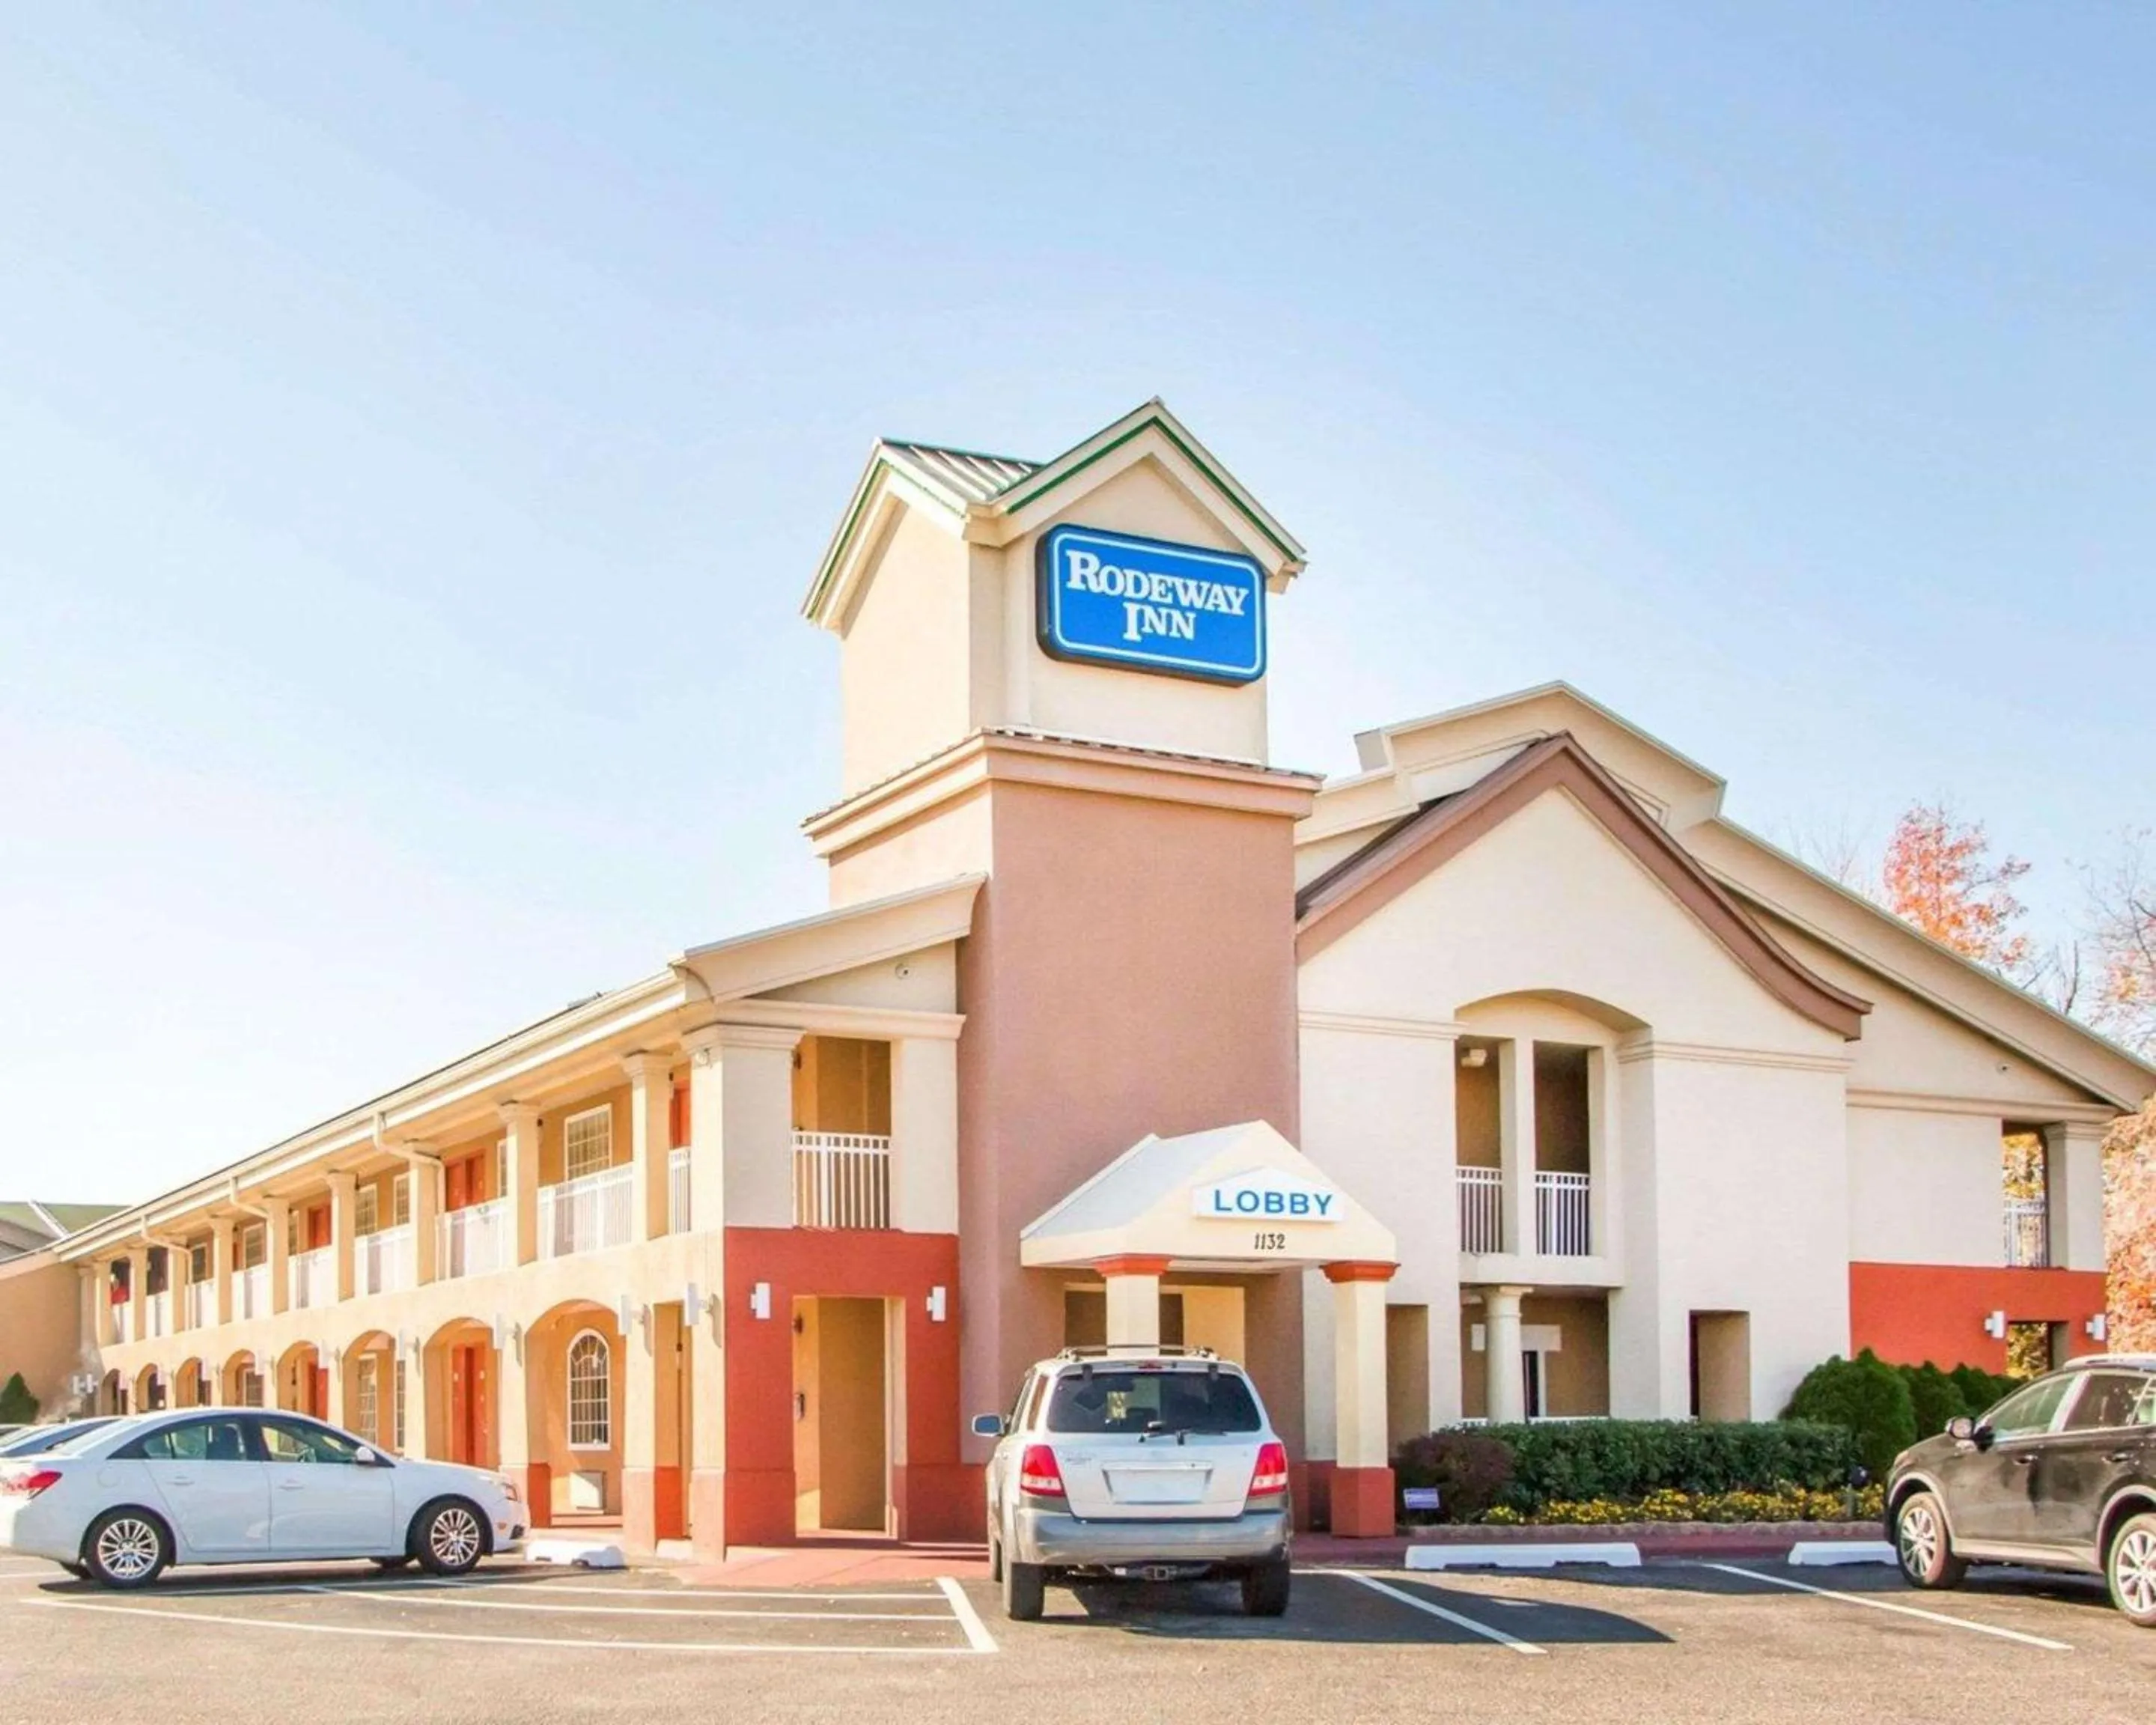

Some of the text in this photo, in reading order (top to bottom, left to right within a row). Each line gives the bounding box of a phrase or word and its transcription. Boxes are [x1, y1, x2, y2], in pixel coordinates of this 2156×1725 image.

[1065, 550, 1249, 616] RODEWAY
[1123, 602, 1196, 642] INN
[1214, 1189, 1333, 1215] LOBBY
[1254, 1232, 1285, 1250] 1132
